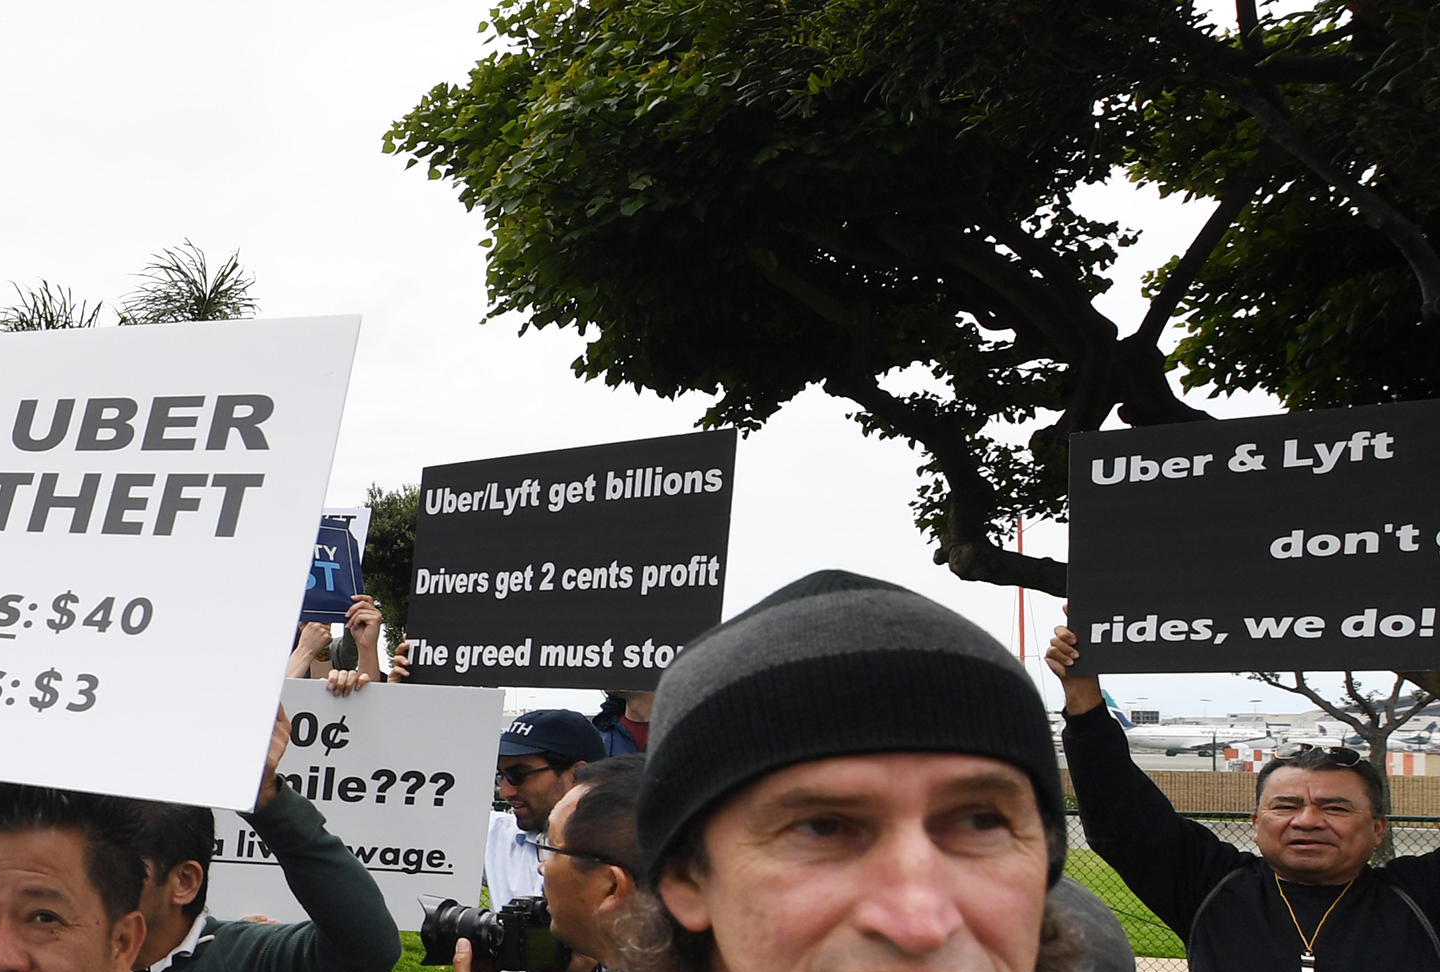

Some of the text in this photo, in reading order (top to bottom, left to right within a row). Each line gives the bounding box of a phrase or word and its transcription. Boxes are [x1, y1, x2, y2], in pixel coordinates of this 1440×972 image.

[11, 394, 275, 452] UBER
[1090, 431, 1395, 485] Uber & Lyft
[425, 466, 724, 516] Uber/Lyft get billions
[1269, 523, 1420, 560] don't
[415, 554, 720, 601] Drivers get 2 cents profit
[1090, 608, 1437, 645] rides, we do!
[404, 637, 684, 674] The greed must sto
[345, 844, 454, 874] wage.
